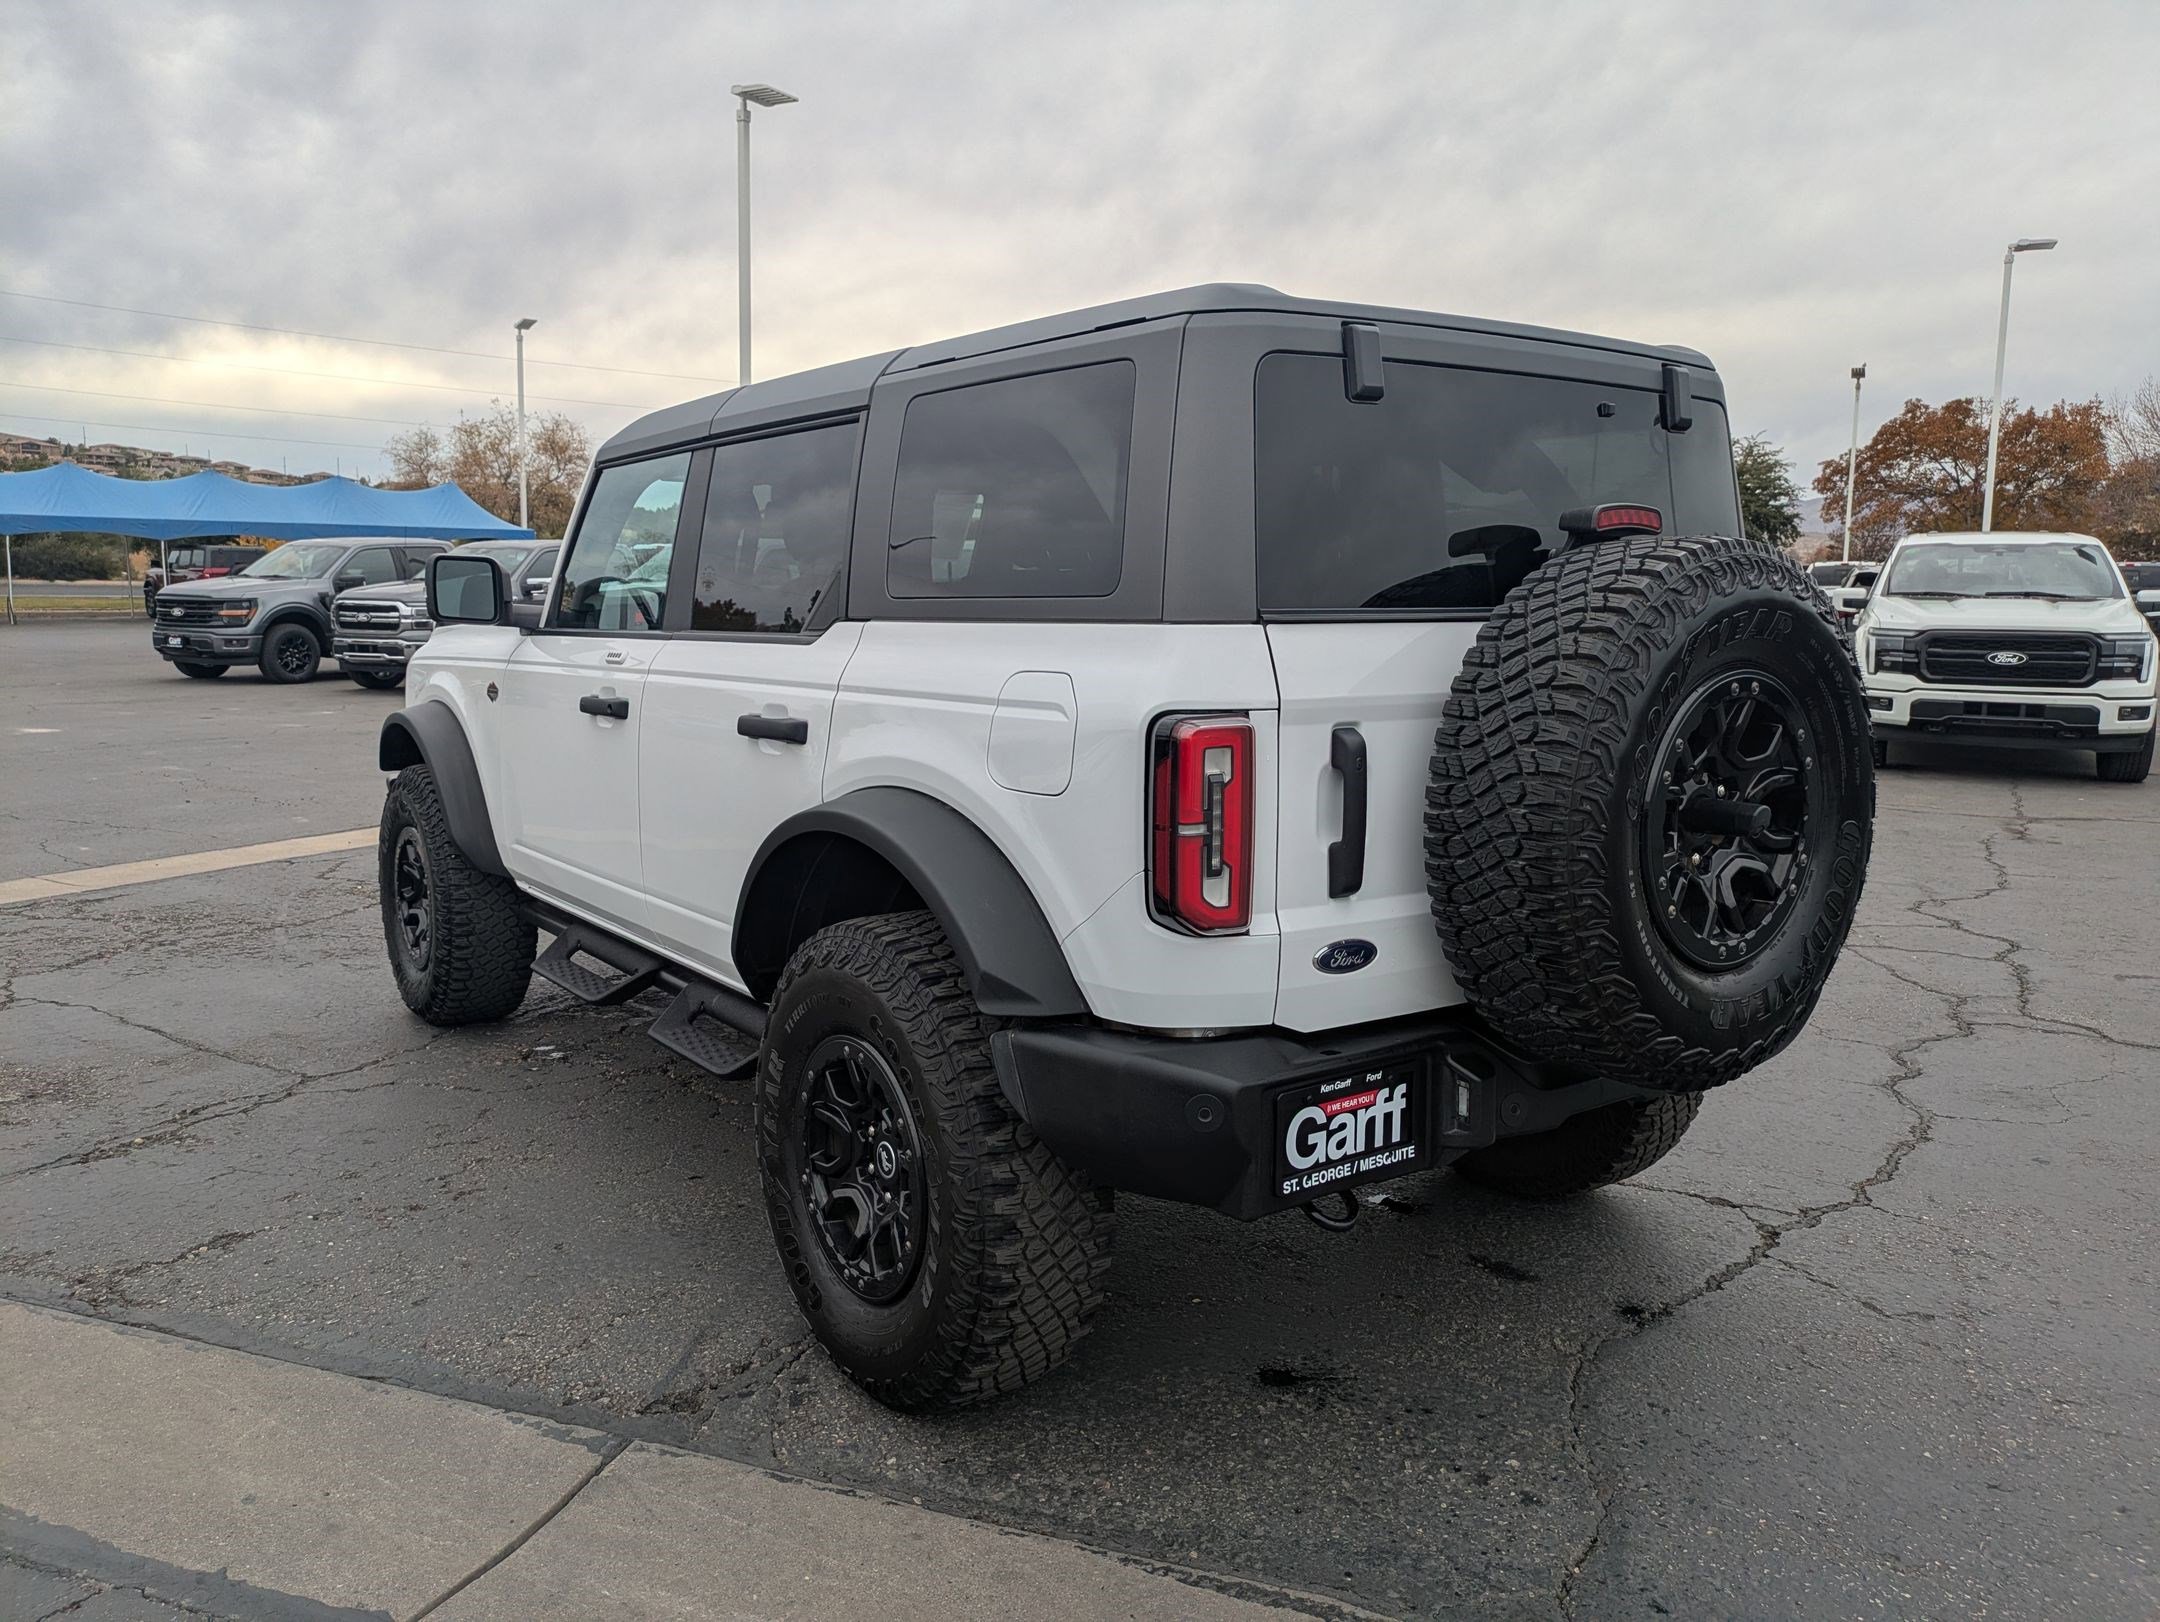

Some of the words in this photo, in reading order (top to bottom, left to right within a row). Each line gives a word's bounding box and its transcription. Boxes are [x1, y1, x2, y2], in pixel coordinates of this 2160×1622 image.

[1320, 1083, 1334, 1094] Ken
[1334, 1078, 1352, 1090] Garff
[1366, 1070, 1383, 1082] Ford
[1331, 1102, 1341, 1111] WE
[1341, 1099, 1358, 1109] HEAR
[1357, 1095, 1370, 1105] YOU
[1285, 1083, 1407, 1170] Garff
[1282, 1178, 1300, 1194] ST.
[1302, 1162, 1352, 1188] GEORGE
[1359, 1145, 1416, 1172] MESQUITE
